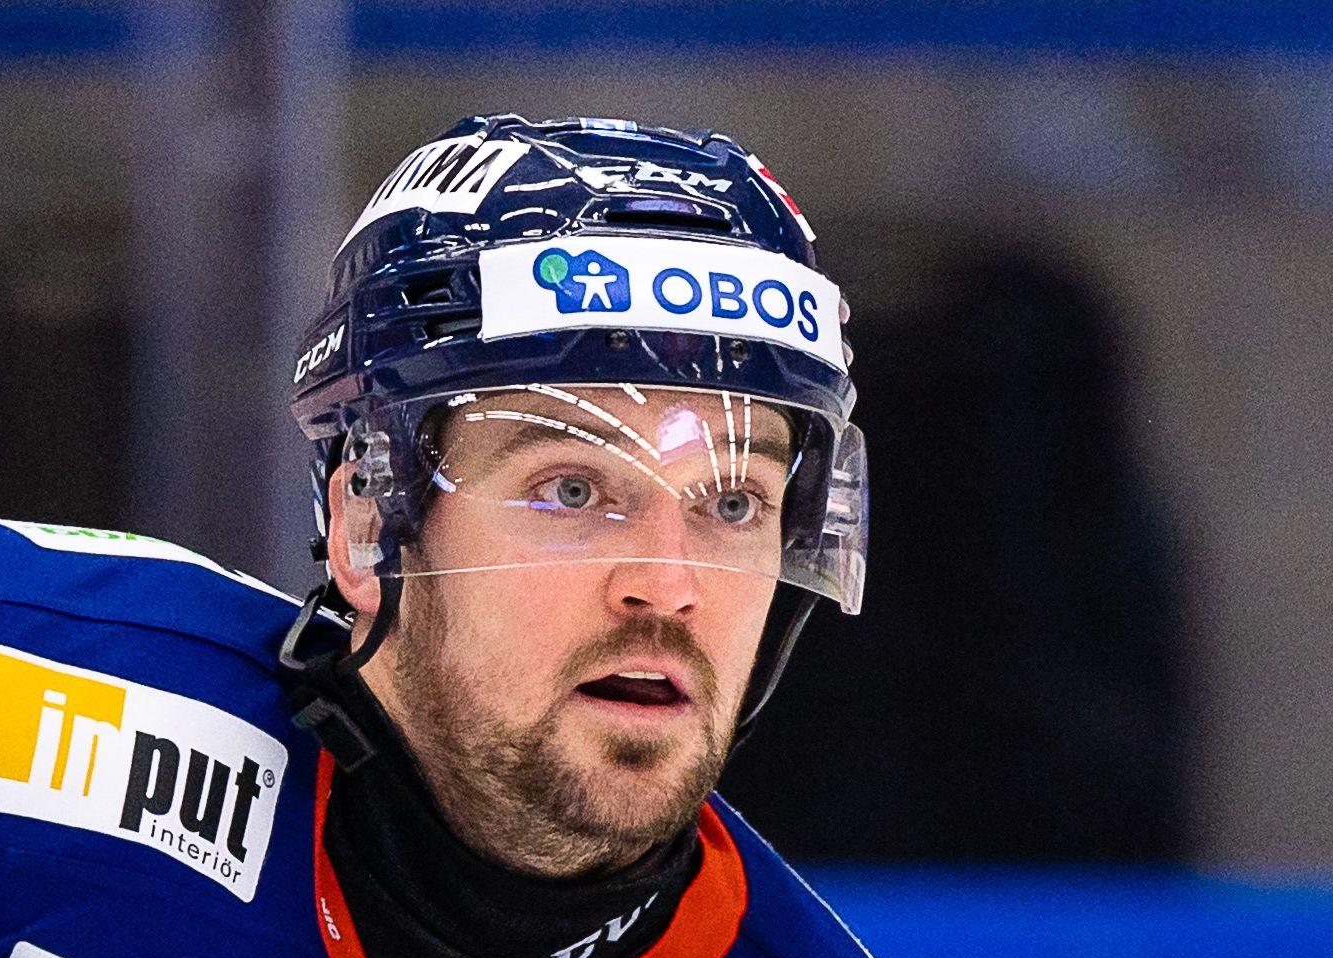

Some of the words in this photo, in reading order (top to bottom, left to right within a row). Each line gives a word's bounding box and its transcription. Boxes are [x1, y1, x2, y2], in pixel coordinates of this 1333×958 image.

[652, 267, 819, 343] OBOS
[294, 324, 345, 383] CCM
[150, 817, 242, 886] interiör
